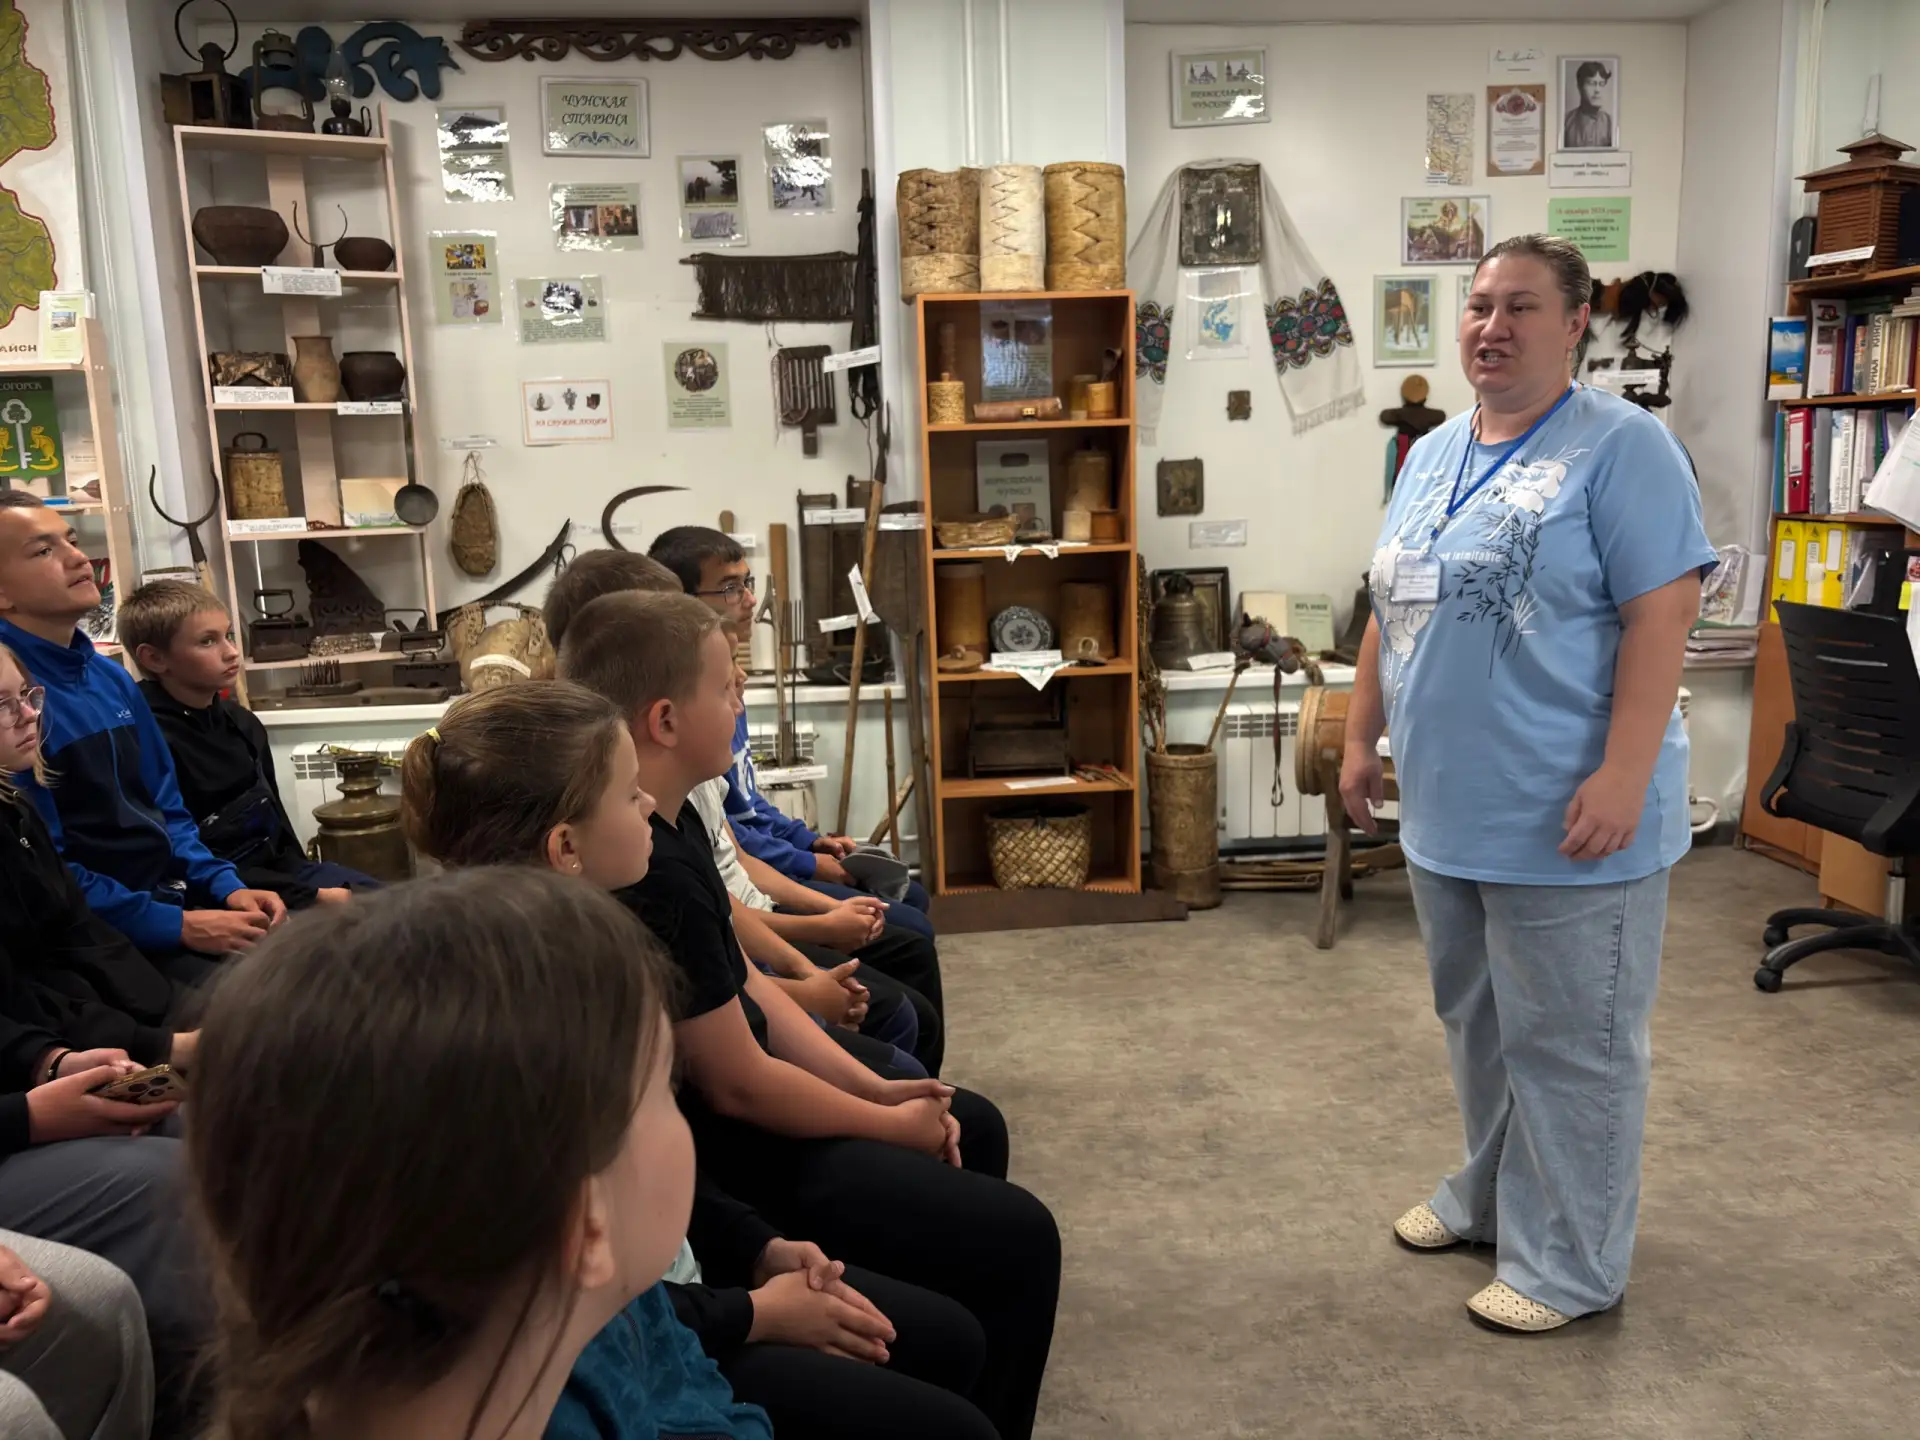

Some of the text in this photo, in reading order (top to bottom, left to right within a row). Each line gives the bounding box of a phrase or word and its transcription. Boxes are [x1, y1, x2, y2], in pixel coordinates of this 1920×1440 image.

[561, 94, 628, 108] ЧУНСКАЯ
[562, 112, 628, 126] СТАРИНА
[1871, 316, 1882, 348] КНИГА
